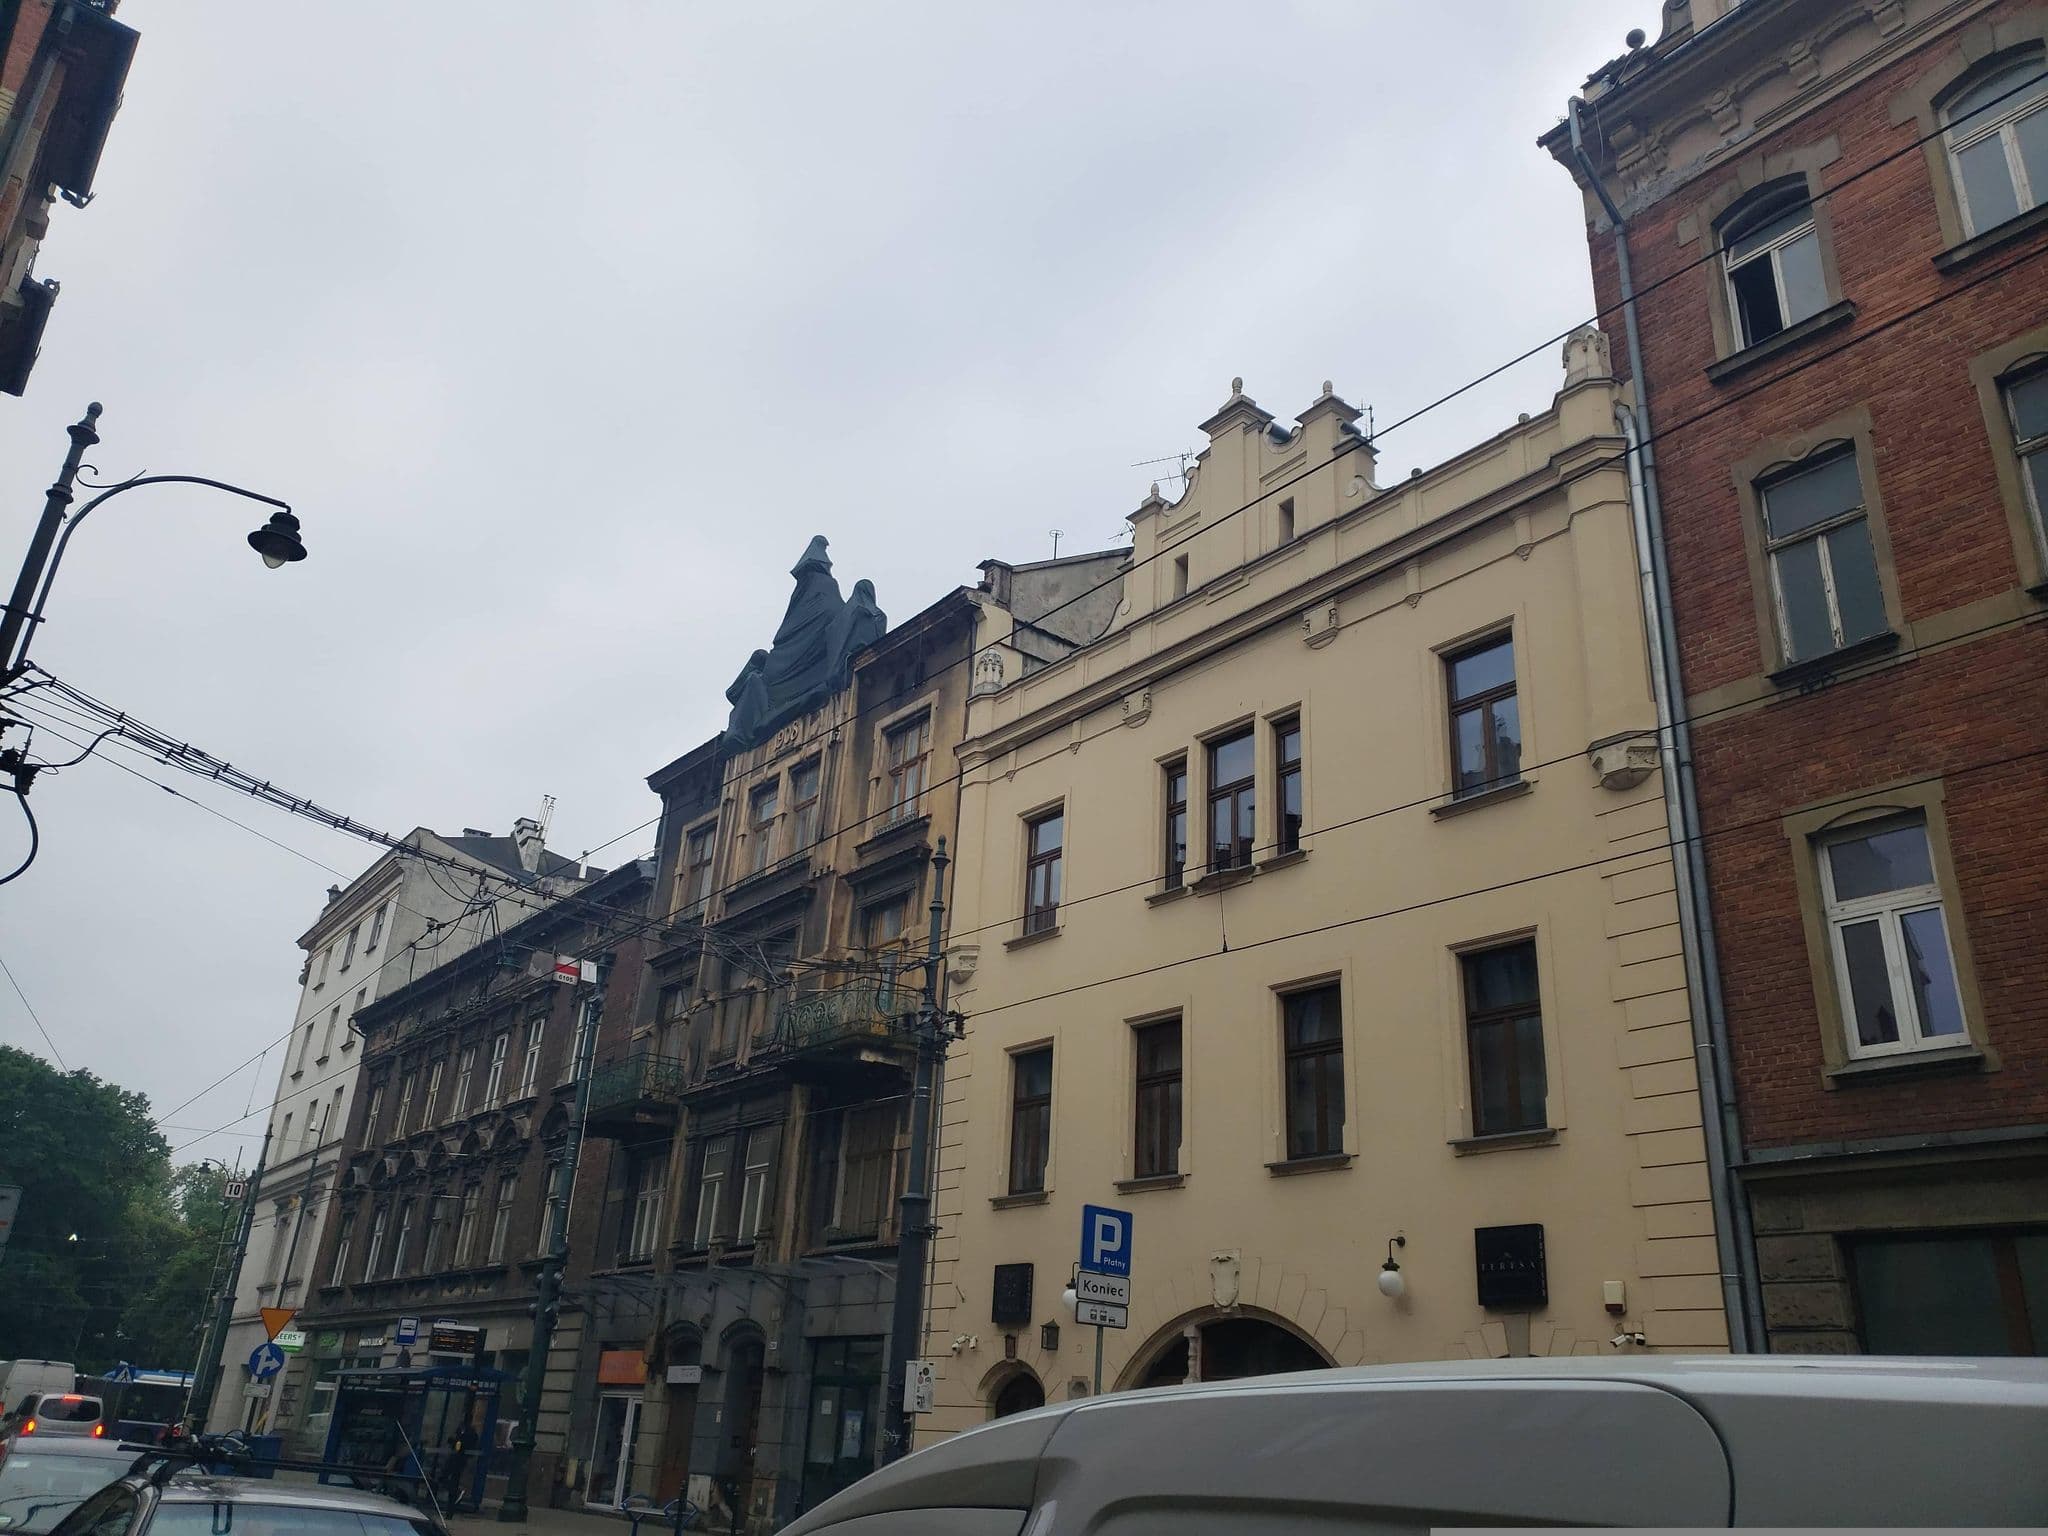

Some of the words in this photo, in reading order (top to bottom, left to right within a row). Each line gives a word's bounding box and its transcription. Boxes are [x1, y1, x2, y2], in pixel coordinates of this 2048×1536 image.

[228, 1183, 241, 1196] 10
[1093, 1213, 1123, 1264] P
[1083, 1279, 1124, 1298] Koniec
